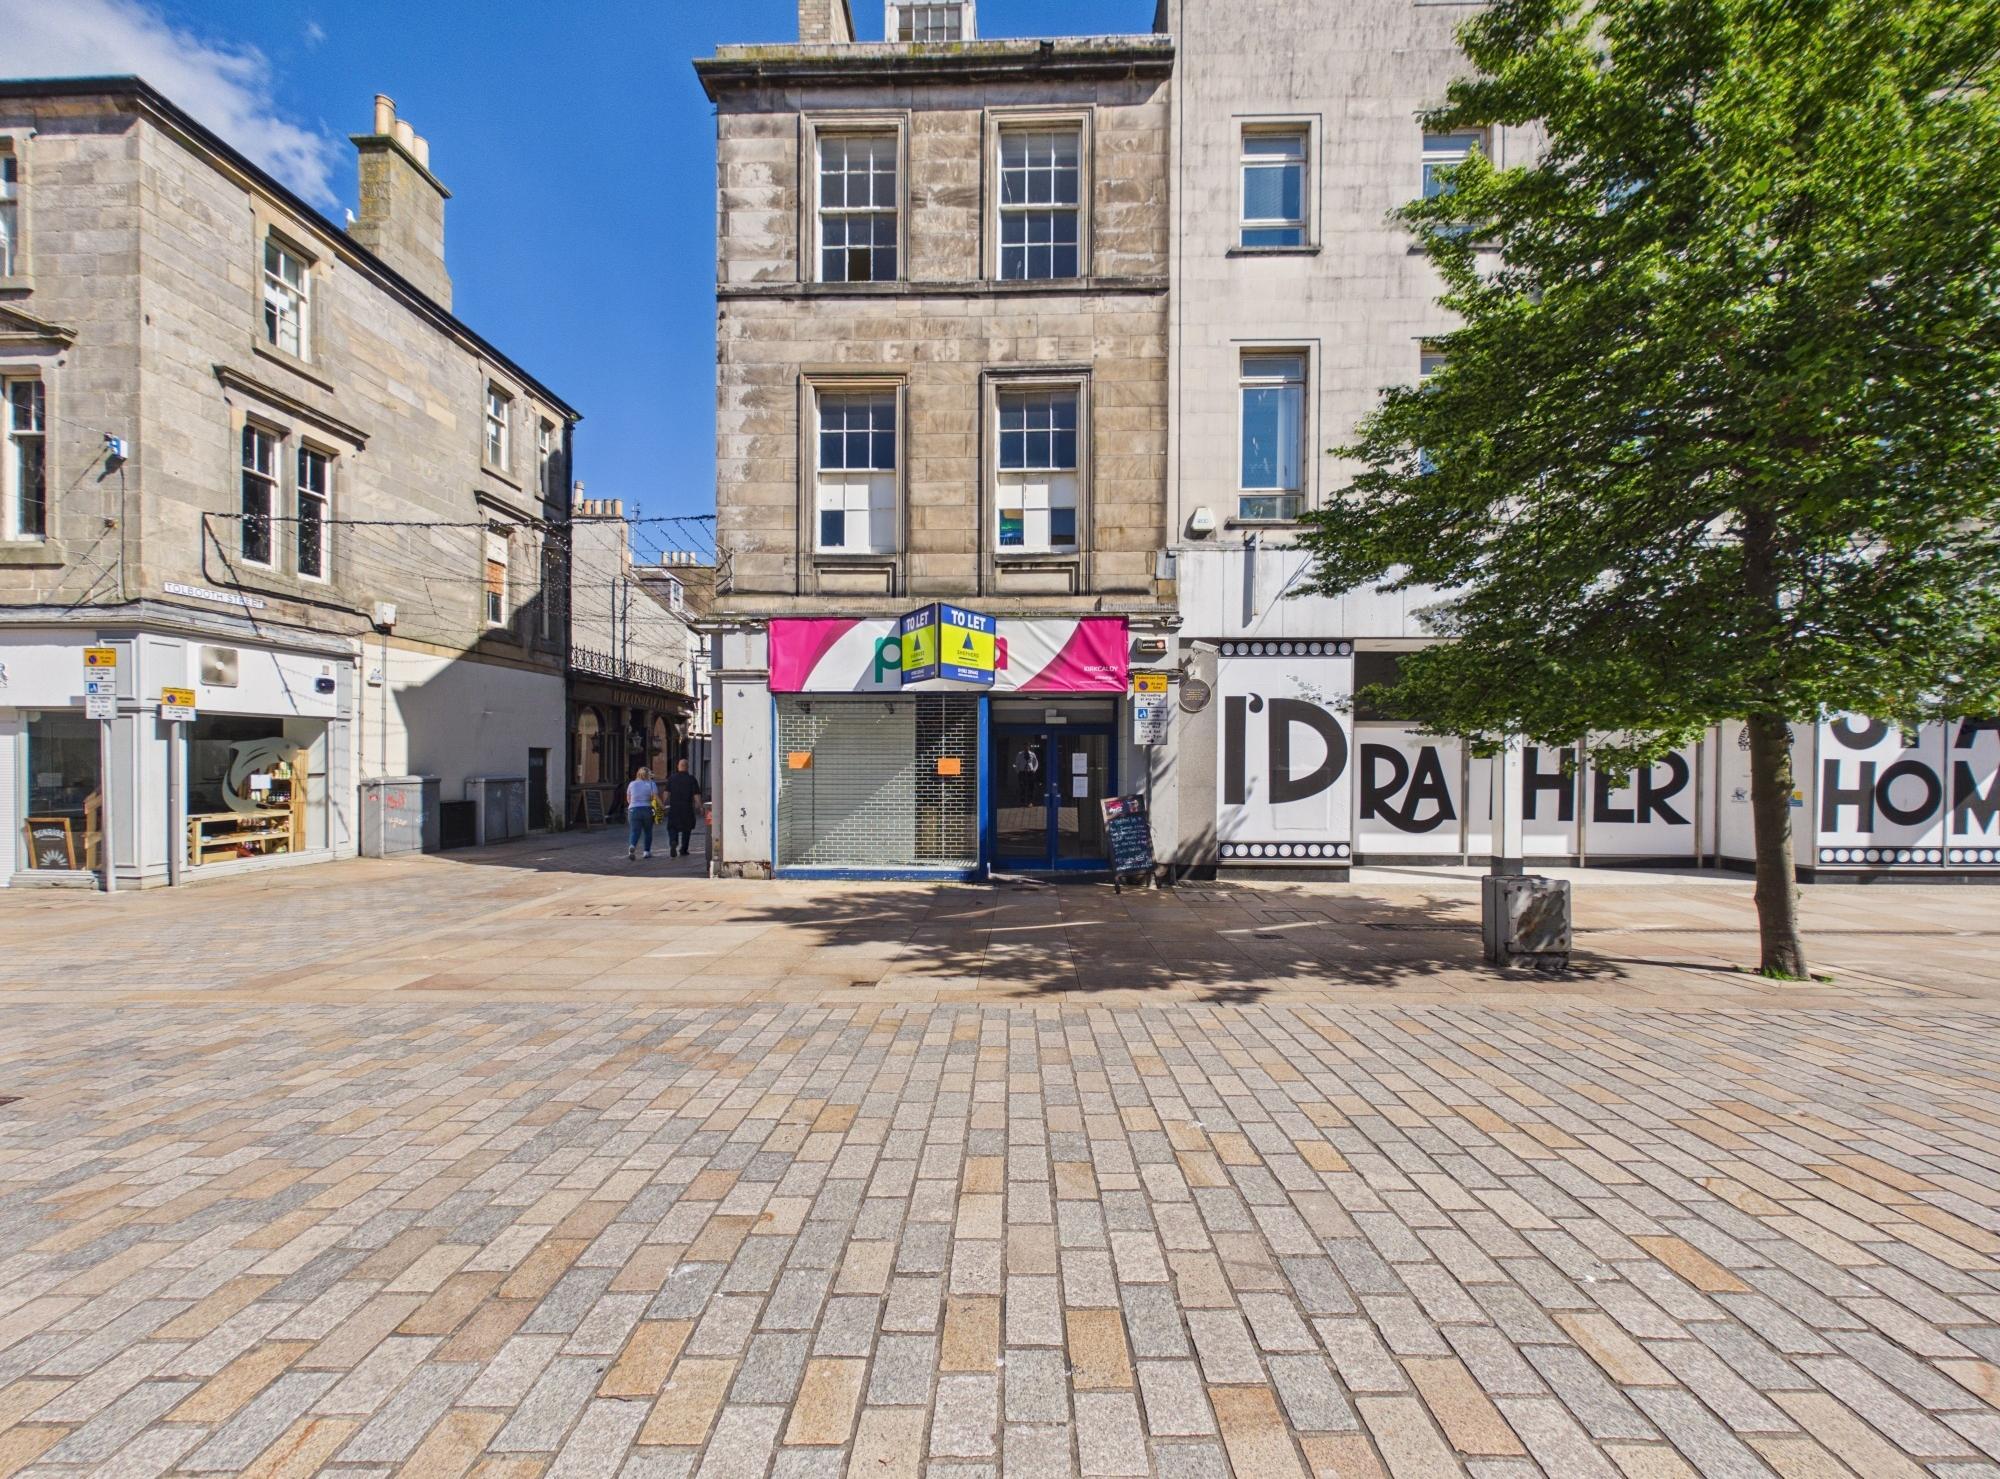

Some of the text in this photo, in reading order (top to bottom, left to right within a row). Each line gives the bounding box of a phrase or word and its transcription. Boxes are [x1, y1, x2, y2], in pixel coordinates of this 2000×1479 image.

[167, 583, 264, 608] TOLBOOTH STREET
[906, 611, 929, 631] TO LET
[951, 609, 986, 631] TO LET
[1224, 692, 1348, 805] I'D
[1821, 758, 2000, 835] HOM
